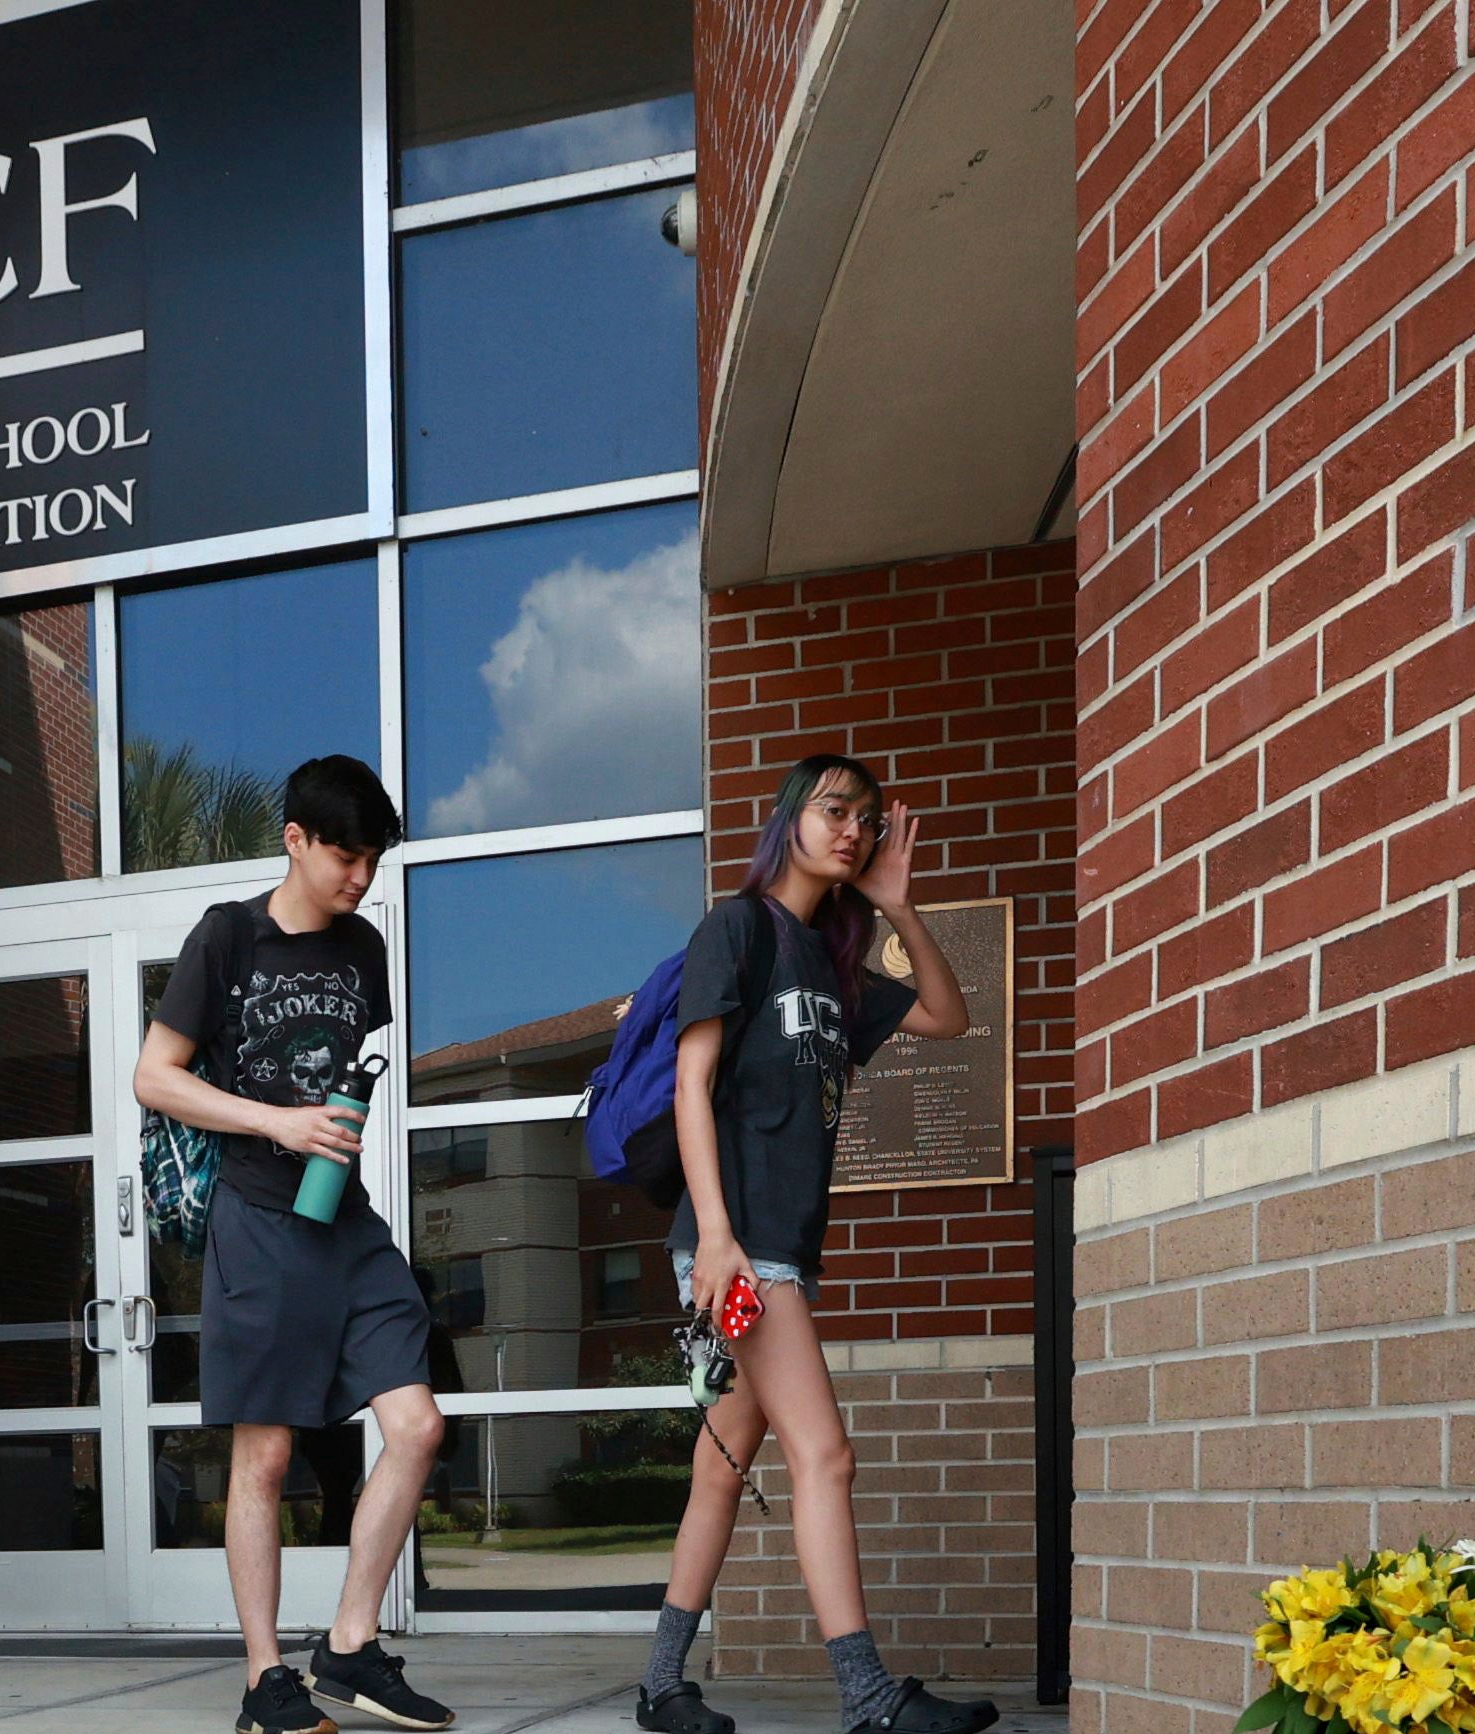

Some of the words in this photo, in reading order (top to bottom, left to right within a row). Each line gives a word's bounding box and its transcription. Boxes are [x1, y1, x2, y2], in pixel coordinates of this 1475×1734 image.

[281, 982, 300, 992] YES
[324, 981, 340, 991] NO
[267, 993, 357, 1026] JOKER
[884, 1068, 914, 1078] BOARD
[916, 1067, 927, 1076] OF
[929, 1064, 969, 1075] REGENTS
